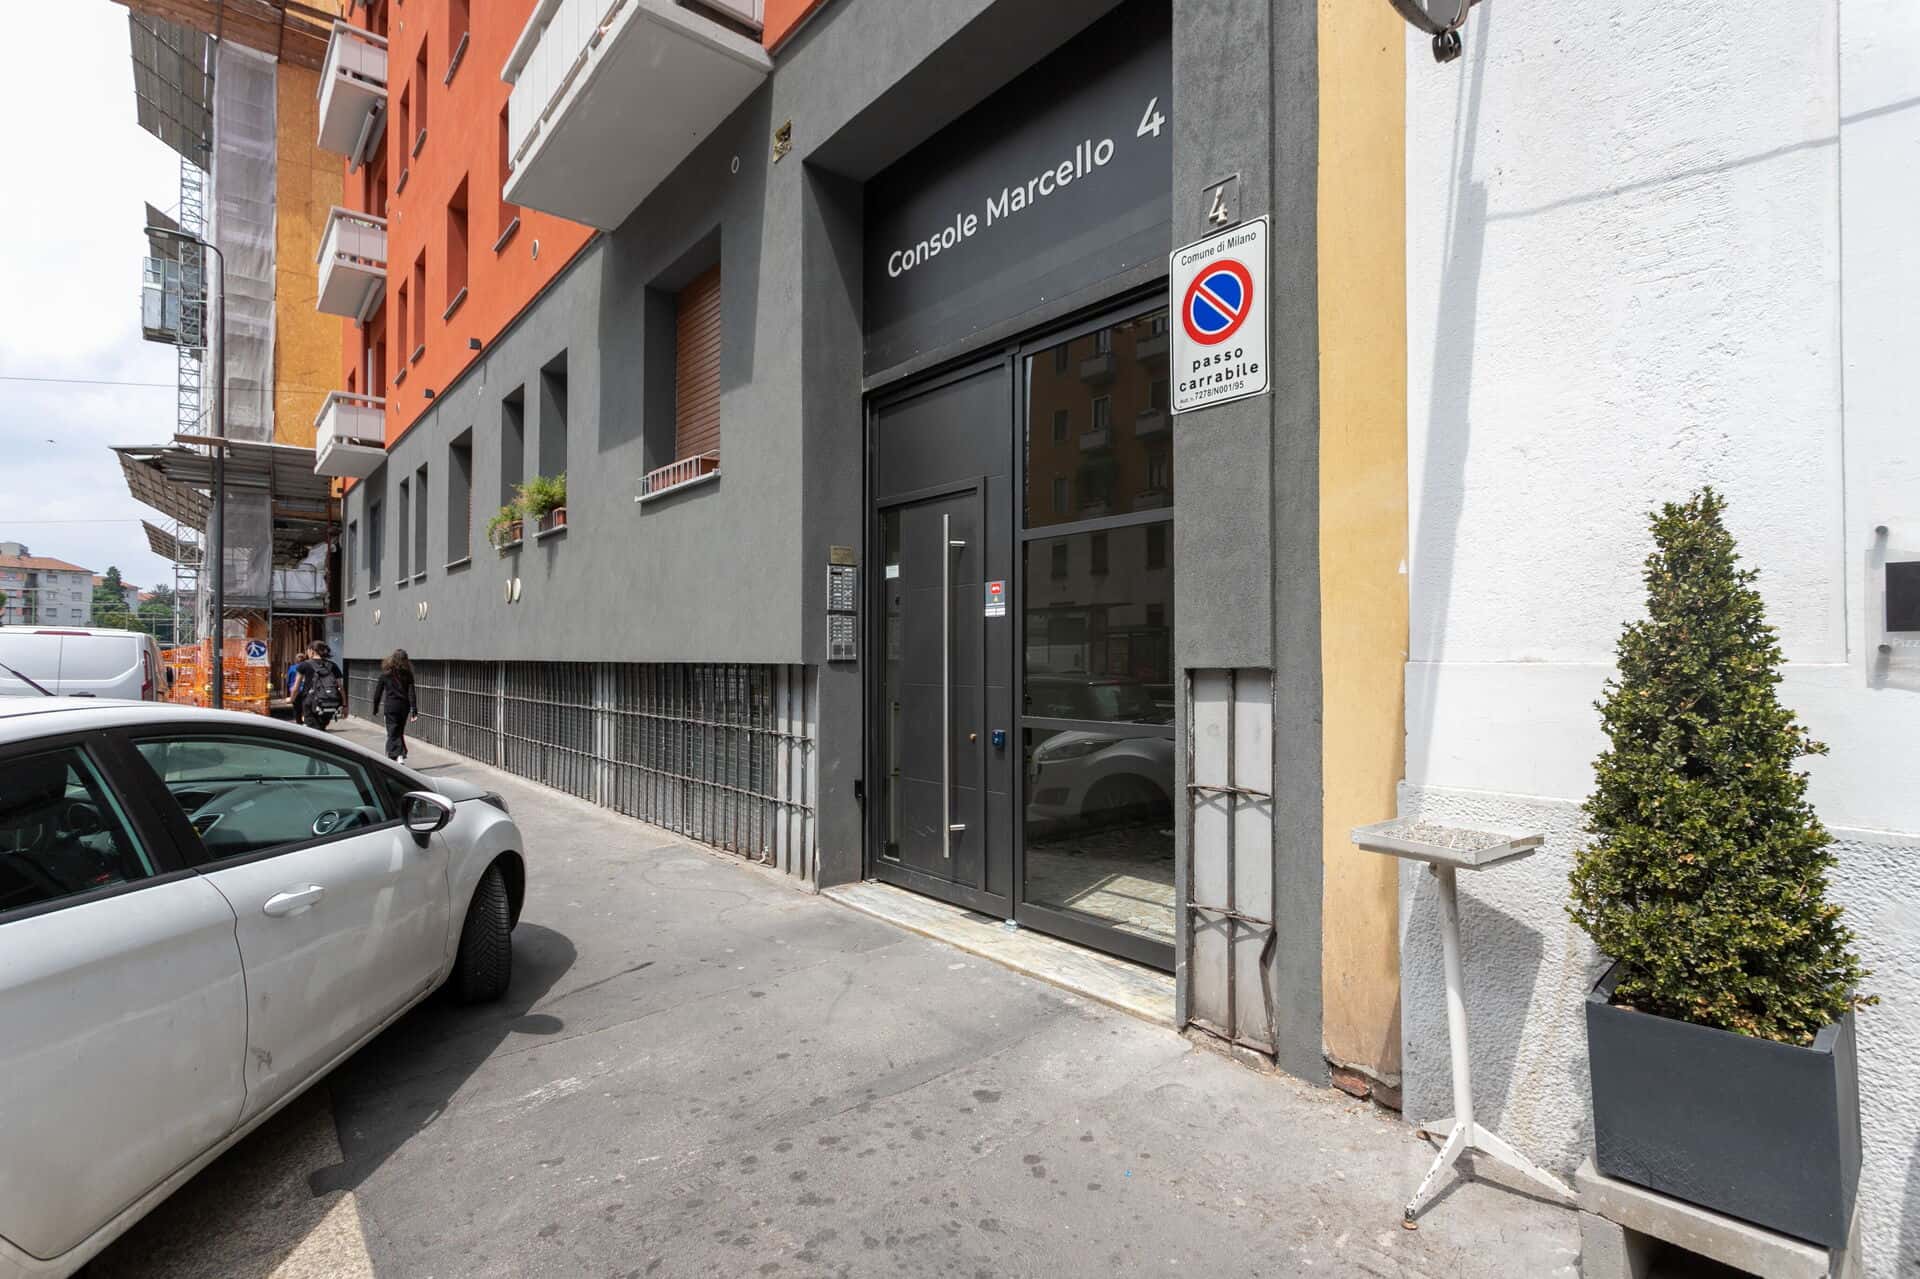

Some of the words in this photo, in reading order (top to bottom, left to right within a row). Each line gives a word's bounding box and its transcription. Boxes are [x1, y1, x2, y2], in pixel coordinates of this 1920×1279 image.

[887, 212, 978, 278] Console
[986, 138, 1115, 227] Marcello
[1136, 96, 1166, 138] 4
[1208, 186, 1228, 225] 4
[1181, 246, 1215, 266] Comune
[1217, 241, 1225, 253] di
[1227, 231, 1257, 249] Milano
[1179, 361, 1259, 392] carrabile
[1192, 347, 1243, 373] passo
